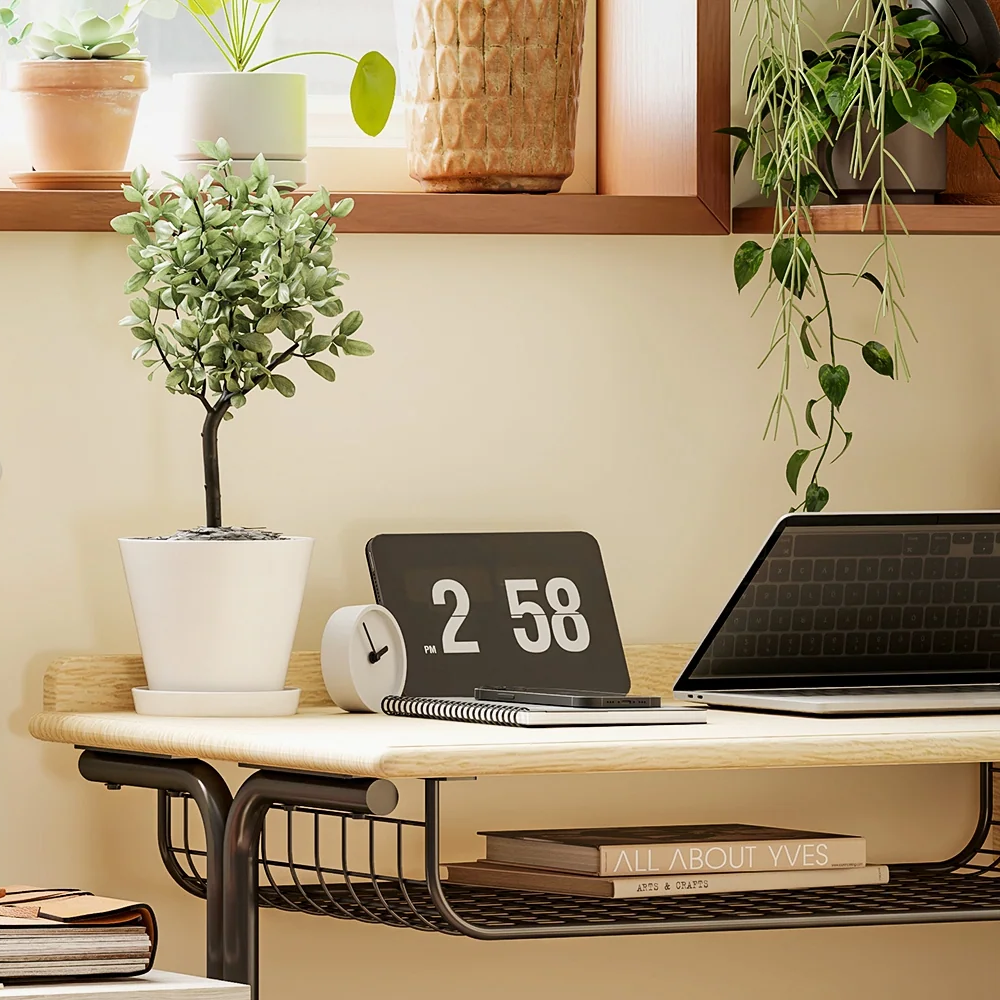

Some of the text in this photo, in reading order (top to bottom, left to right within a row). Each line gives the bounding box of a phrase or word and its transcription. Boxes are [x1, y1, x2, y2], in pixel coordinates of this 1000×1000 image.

[432, 577, 591, 654] 2 58
[424, 645, 437, 654] PM
[613, 849, 660, 873] ALL
[668, 846, 757, 872] ABOUT
[767, 843, 829, 868] YVES
[636, 880, 709, 892] ARTS & CRAFTS
